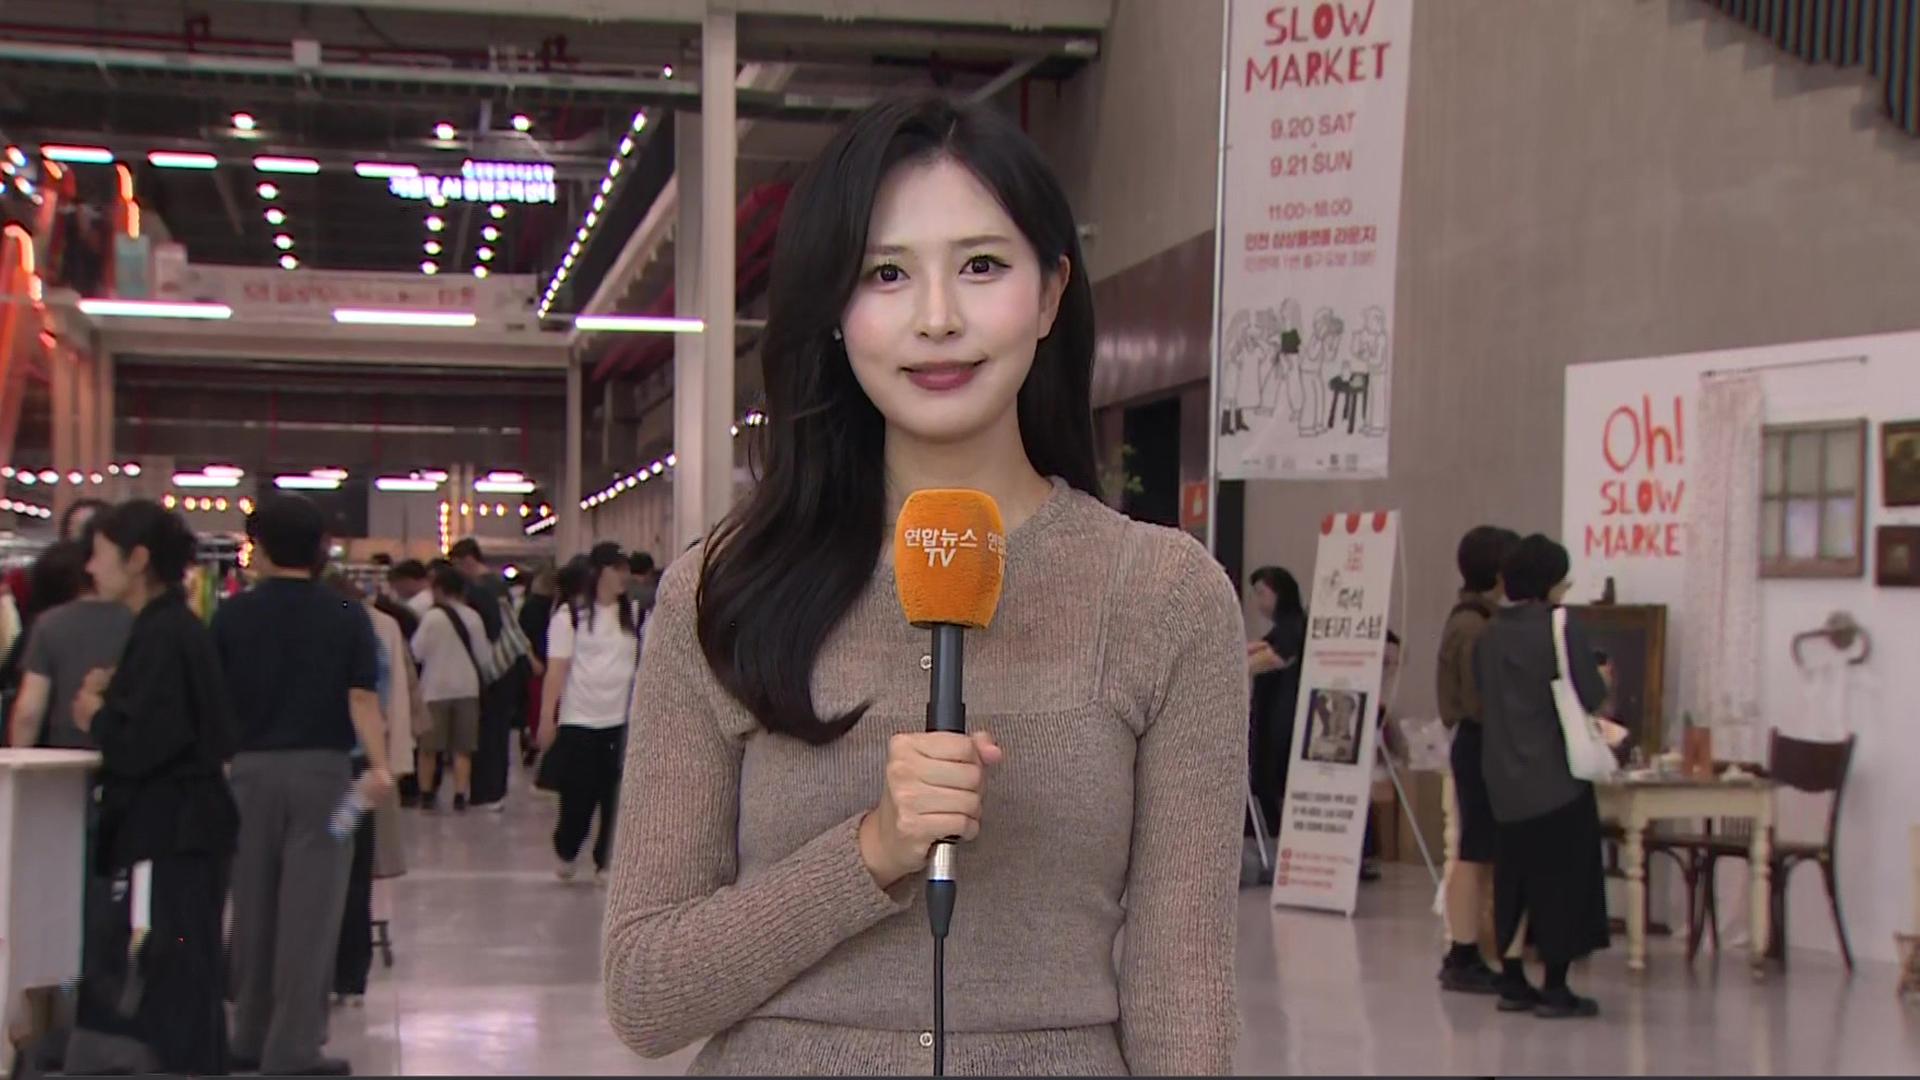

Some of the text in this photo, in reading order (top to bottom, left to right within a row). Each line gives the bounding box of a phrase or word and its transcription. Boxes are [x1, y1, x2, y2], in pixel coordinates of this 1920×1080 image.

[1264, 0, 1376, 46] SLOW
[1245, 40, 1391, 93] MARKET
[1270, 112, 1356, 140] 9.20 SAT
[1269, 150, 1352, 177] 9.21 SUN
[1603, 395, 1684, 472] Oh!
[1601, 479, 1685, 515] SLOW
[904, 528, 978, 548] 연합뉴스
[1585, 522, 1683, 557] MARKE
[924, 548, 957, 568] TV
